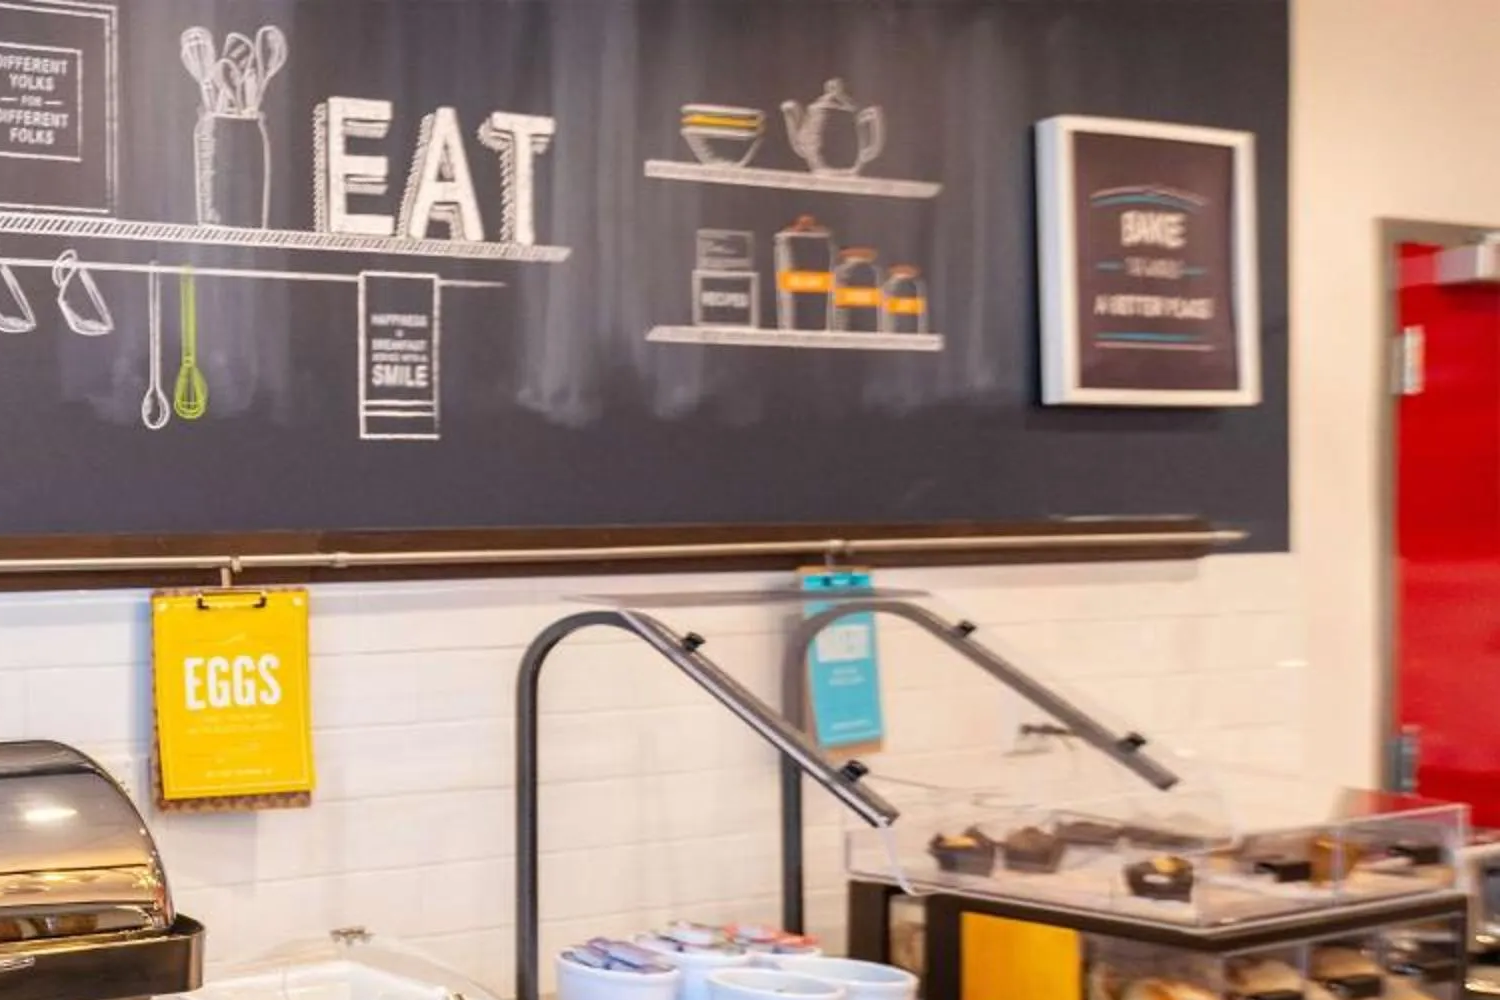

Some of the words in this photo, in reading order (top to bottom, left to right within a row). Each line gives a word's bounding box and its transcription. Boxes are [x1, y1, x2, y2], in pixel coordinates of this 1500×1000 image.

[9, 73, 55, 92] YOLKS
[10, 127, 55, 145] FOLKS
[313, 96, 556, 244] EAT
[1121, 210, 1186, 248] BAKE
[372, 363, 428, 388] SMILE
[184, 654, 283, 710] EGGS
